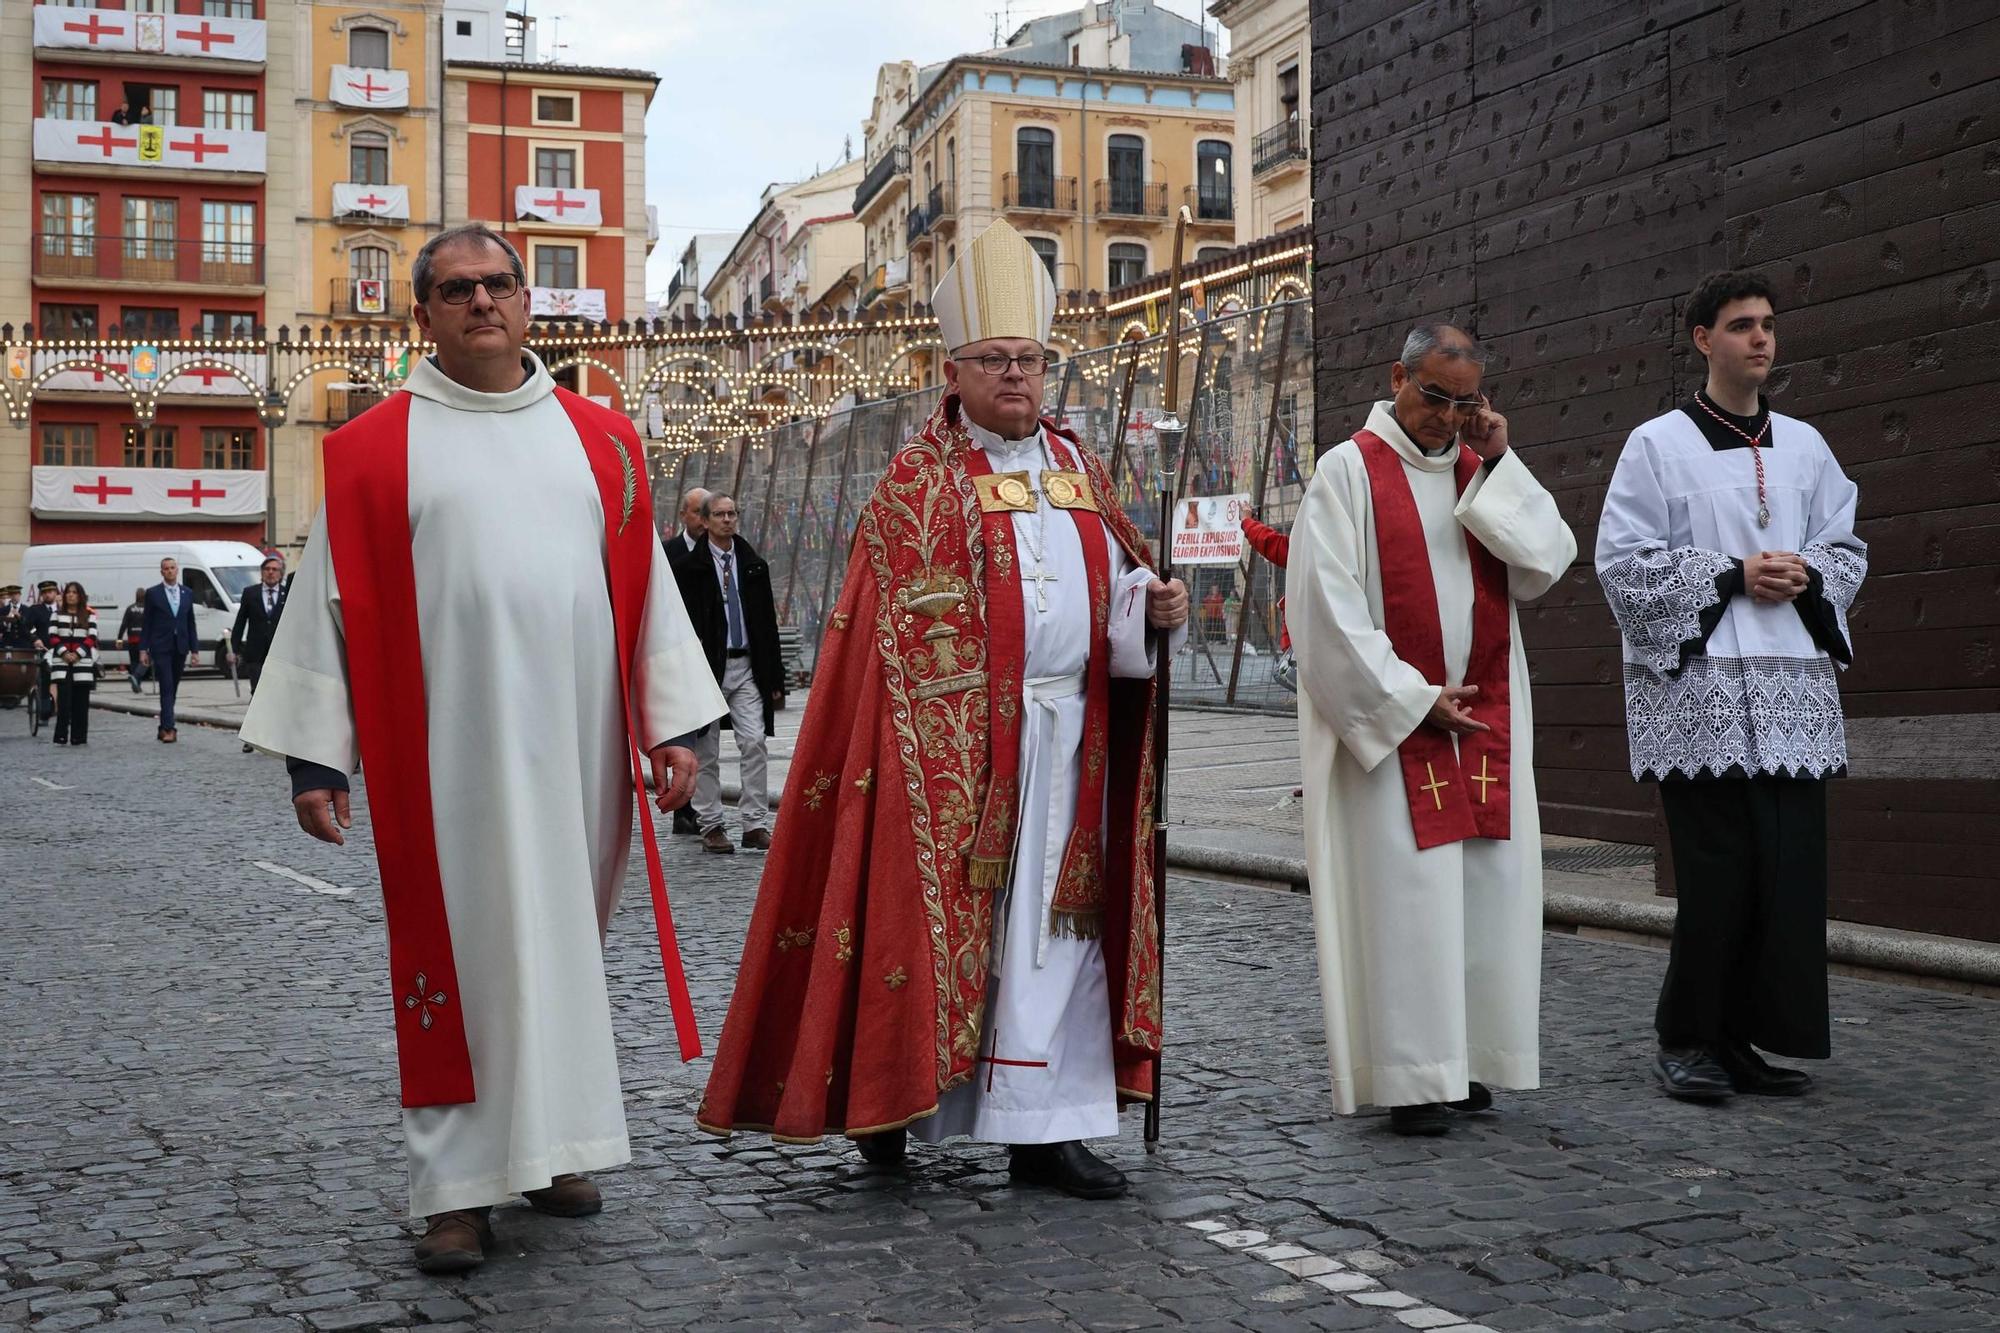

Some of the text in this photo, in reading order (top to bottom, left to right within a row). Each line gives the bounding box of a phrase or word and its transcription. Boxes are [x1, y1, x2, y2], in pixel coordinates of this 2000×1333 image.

[1176, 533, 1200, 544] PERILL
[1172, 543, 1241, 558] ELIGRO EXPLOSIVOS
